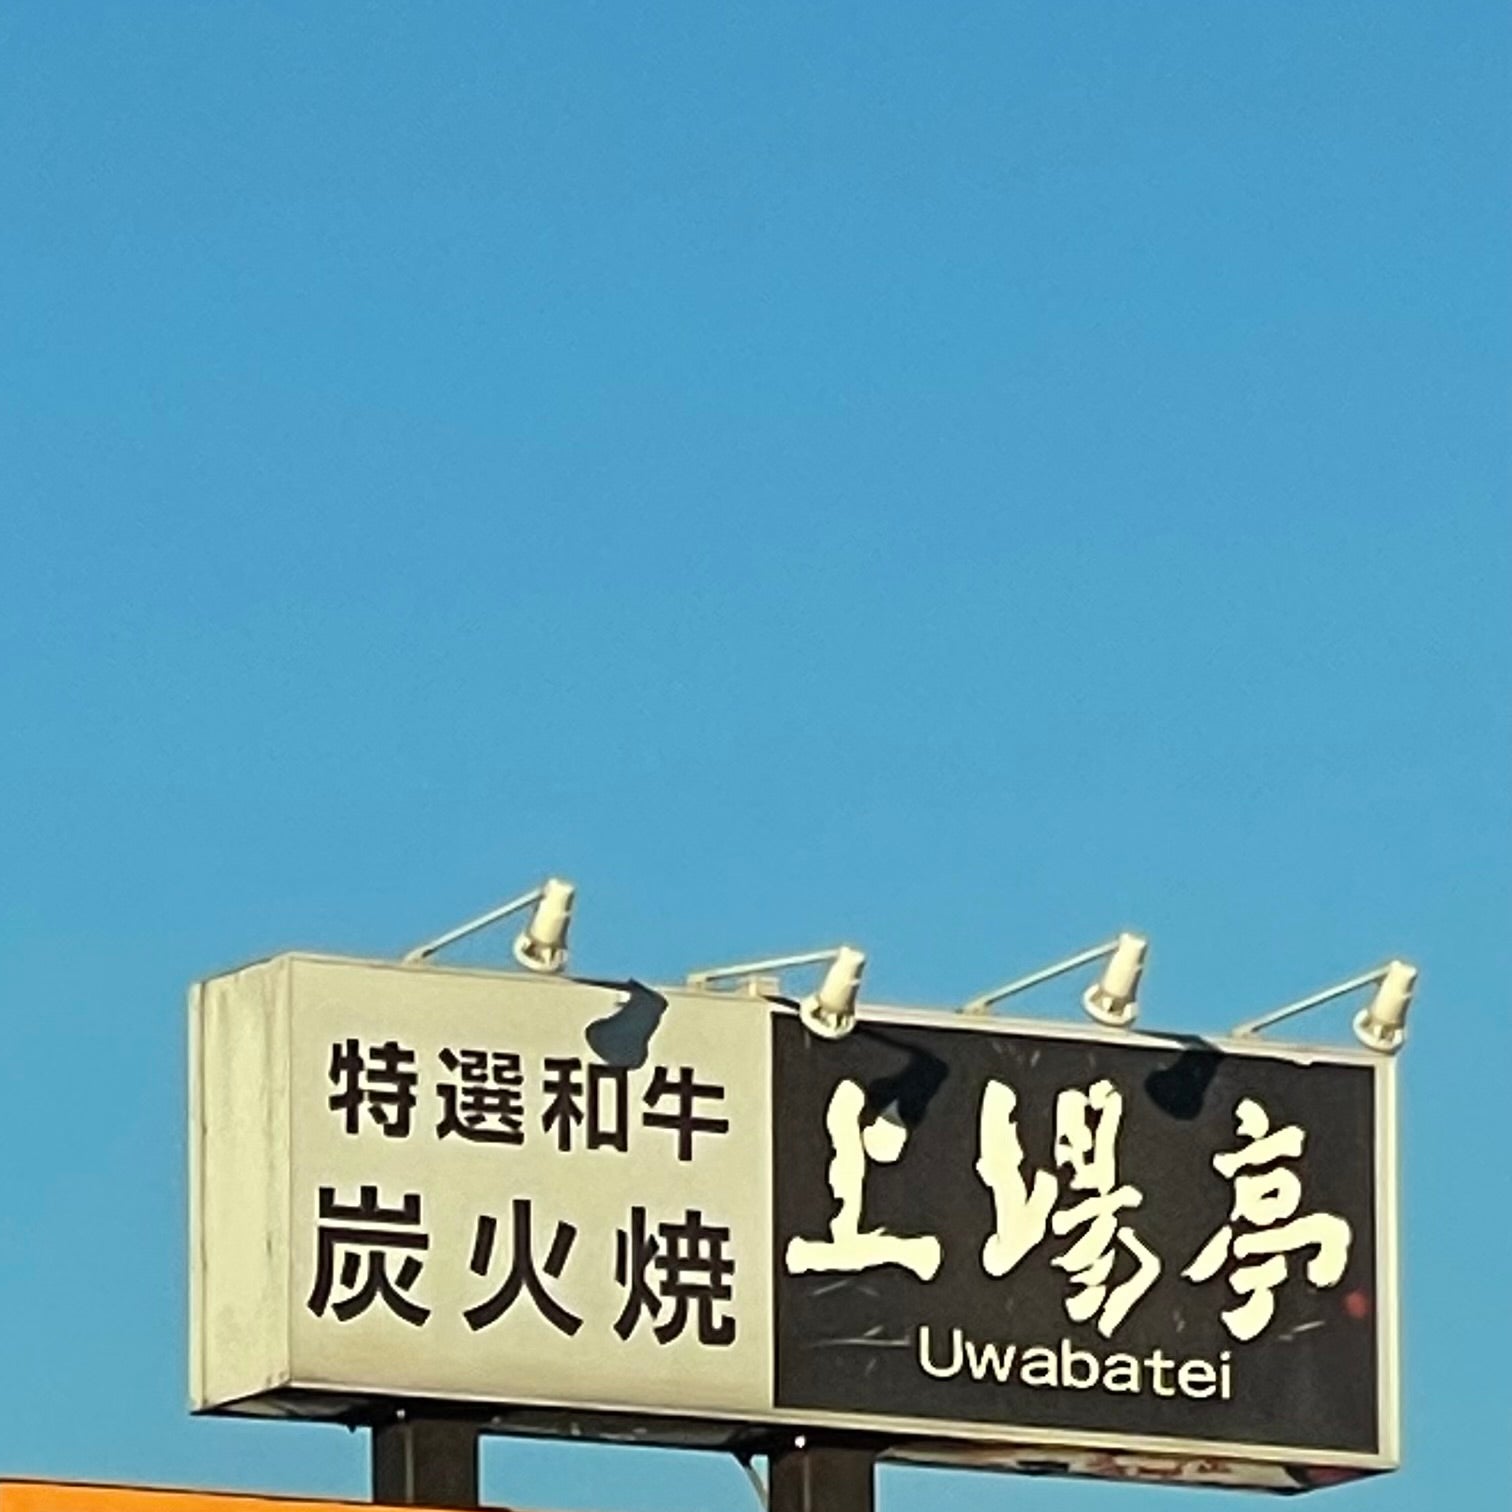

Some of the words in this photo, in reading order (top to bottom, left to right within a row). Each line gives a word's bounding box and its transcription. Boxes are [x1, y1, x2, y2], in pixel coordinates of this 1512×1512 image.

[326, 1038, 731, 1162] 特選和牛
[306, 1185, 738, 1346] 炭火焼
[786, 1078, 1351, 1341] 上場亭
[919, 1326, 1234, 1402] Uwabatei
